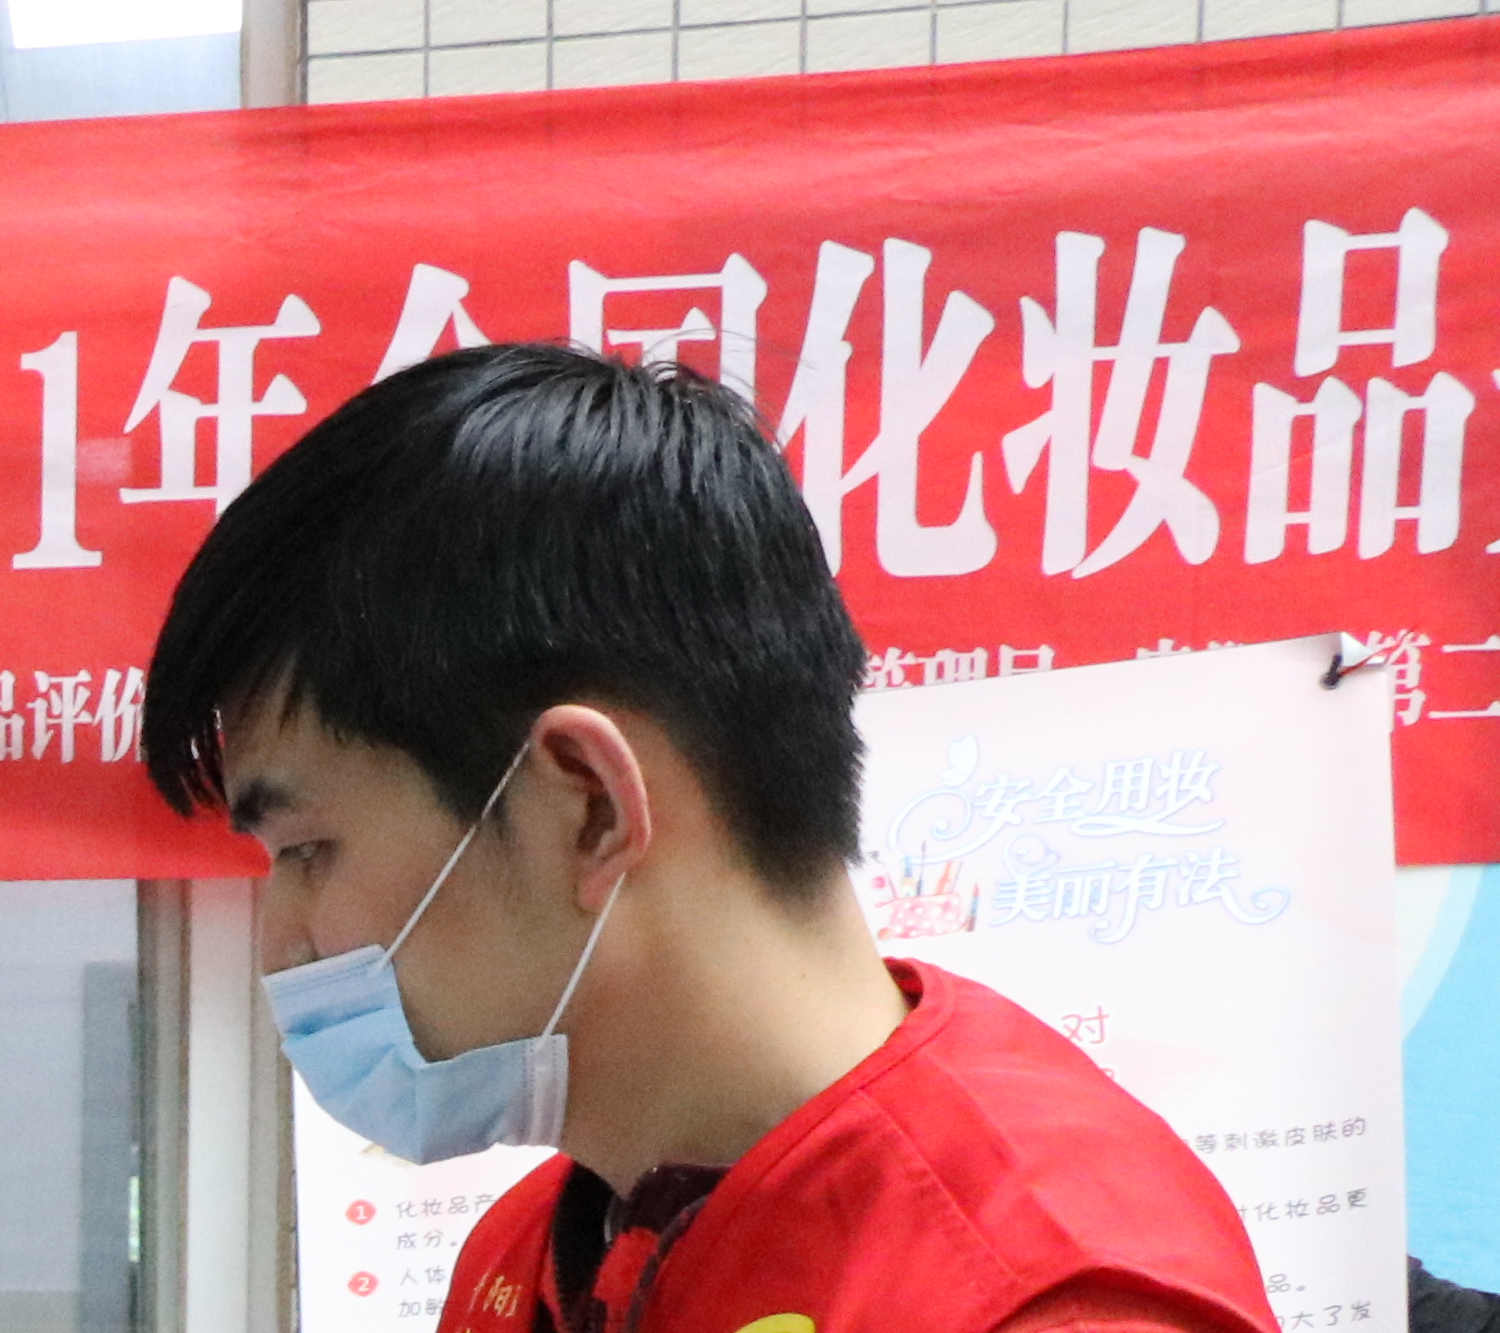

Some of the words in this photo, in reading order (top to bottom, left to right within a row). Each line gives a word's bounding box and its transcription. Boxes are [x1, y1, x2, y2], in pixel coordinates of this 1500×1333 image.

[973, 749, 1225, 838] 安全用妆
[989, 845, 1290, 944] 美丽有法
[1187, 1116, 1367, 1155] 等刺激皮肤的
